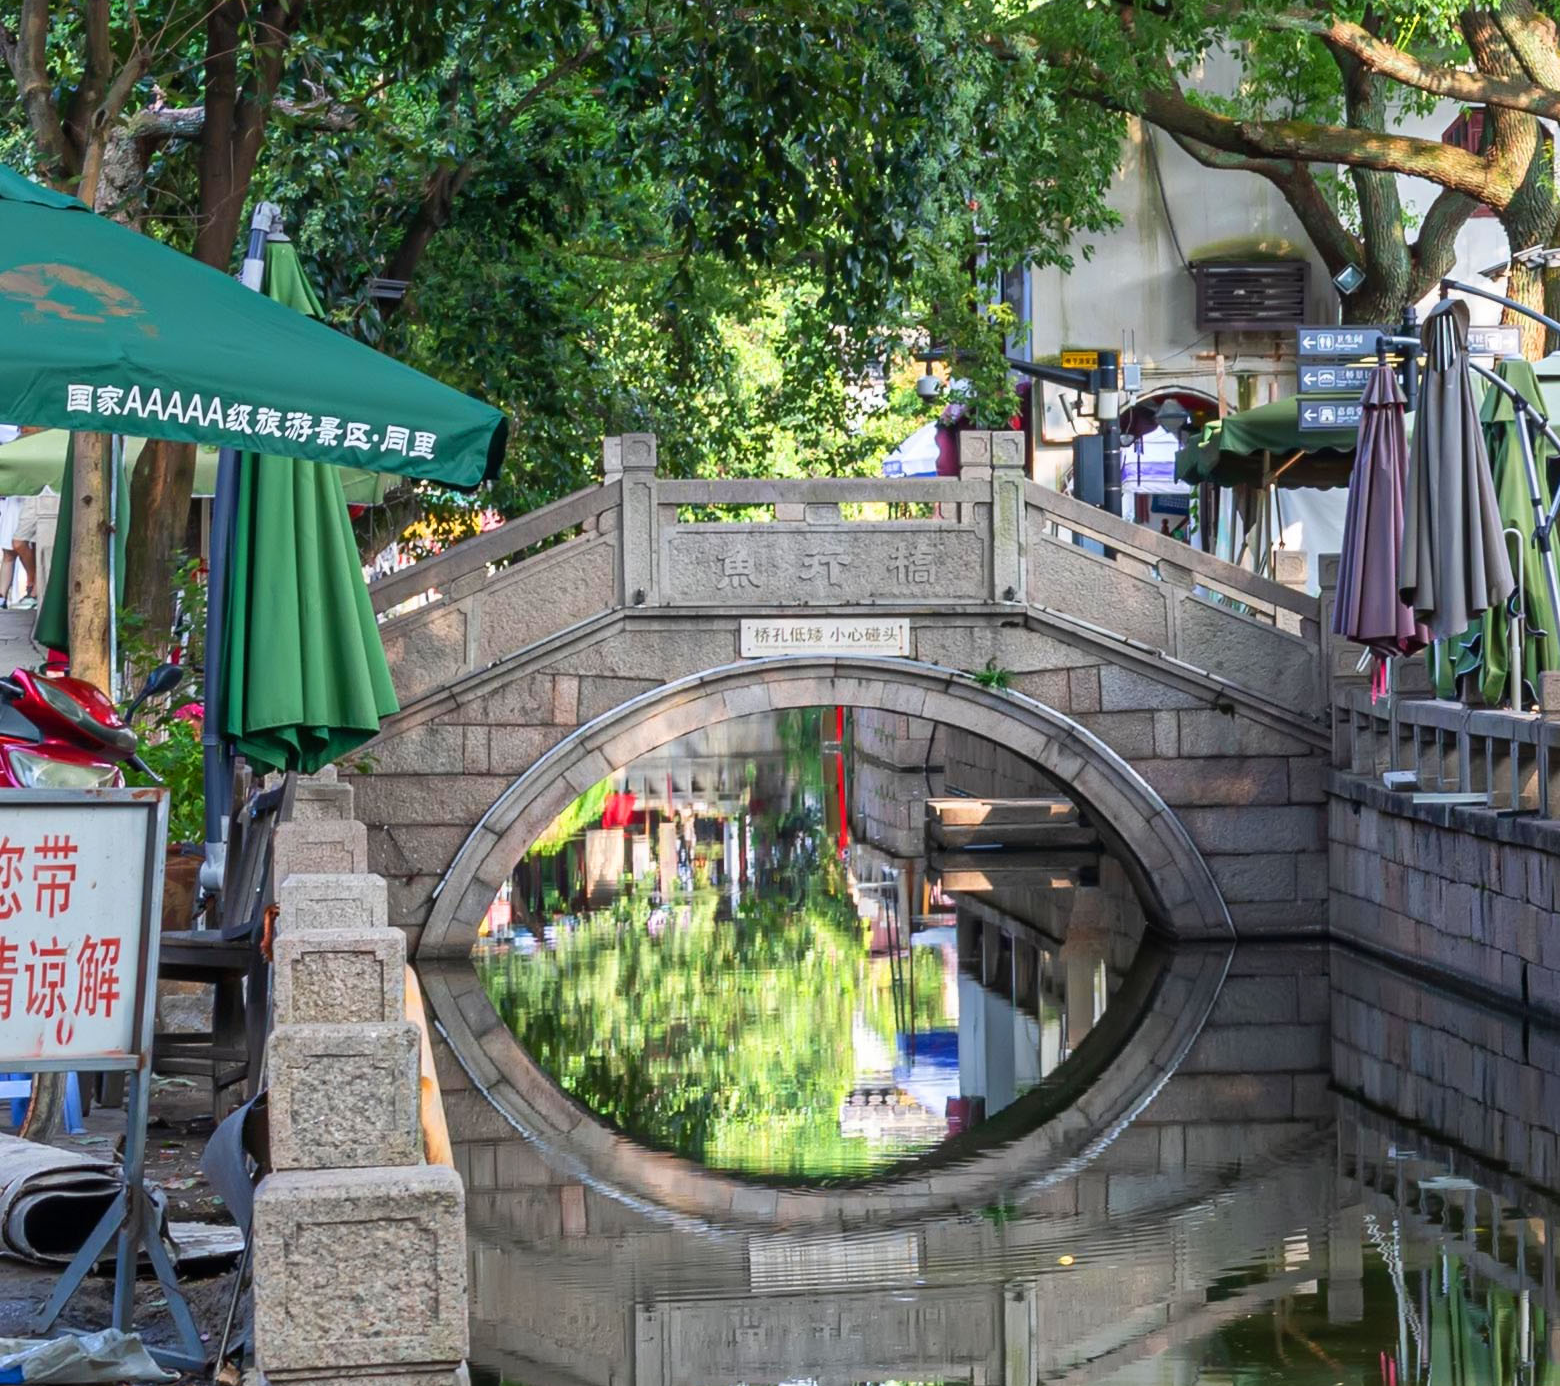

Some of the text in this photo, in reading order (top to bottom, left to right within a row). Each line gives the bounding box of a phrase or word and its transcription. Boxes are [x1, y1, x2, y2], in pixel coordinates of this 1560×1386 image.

[66, 384, 437, 460] 国家AAAAA级旅游景区·同里
[753, 626, 898, 644] 桥孔低矮 小心碰头
